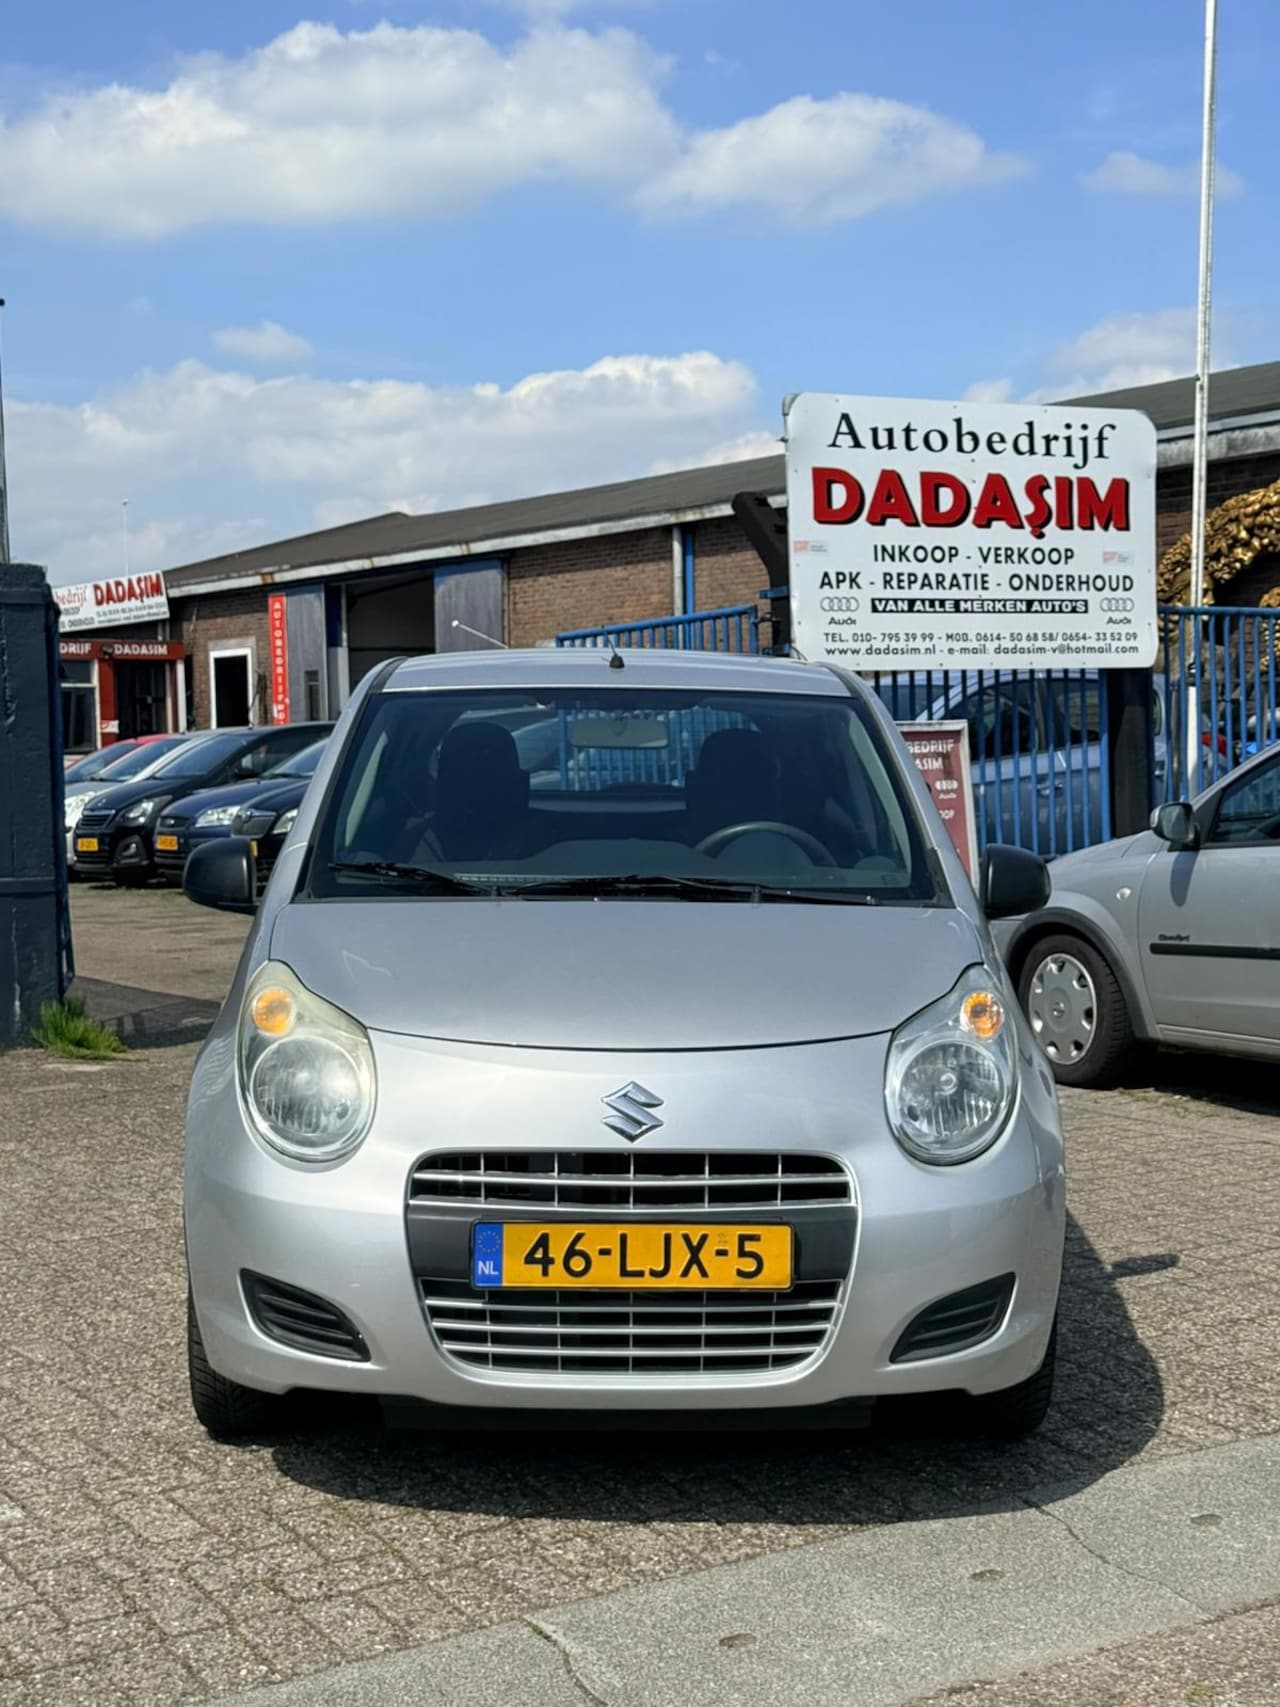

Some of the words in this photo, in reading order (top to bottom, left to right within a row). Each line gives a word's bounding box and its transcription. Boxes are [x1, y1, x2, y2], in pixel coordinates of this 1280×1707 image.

[827, 412, 1117, 470] Autobedrijf
[811, 466, 1131, 539] DADAŞIM
[873, 544, 959, 563] INKOOP
[978, 546, 1075, 565] VERKOOP
[819, 571, 862, 590] APK
[883, 572, 990, 591] REPARATIE
[1008, 573, 1134, 592] ONDERHOUD
[874, 600, 908, 612] VAN
[913, 600, 955, 612] ALLE
[959, 600, 1027, 612] MERKEN
[1030, 600, 1086, 612] AUTO'S
[828, 617, 857, 625] Audi
[1106, 616, 1132, 625] Audi
[824, 632, 849, 643] TEL.
[881, 632, 901, 643] 795
[903, 632, 917, 643] 39
[920, 632, 934, 643] 99
[1009, 632, 1023, 642] 50
[1025, 632, 1039, 642] 68
[1095, 632, 1108, 642] 33
[1110, 632, 1122, 642] 52
[1125, 632, 1138, 642] 09
[824, 644, 936, 656] www.dadasim.nl
[523, 1231, 764, 1279] 46-LJX-5
[477, 1260, 499, 1276] NL
